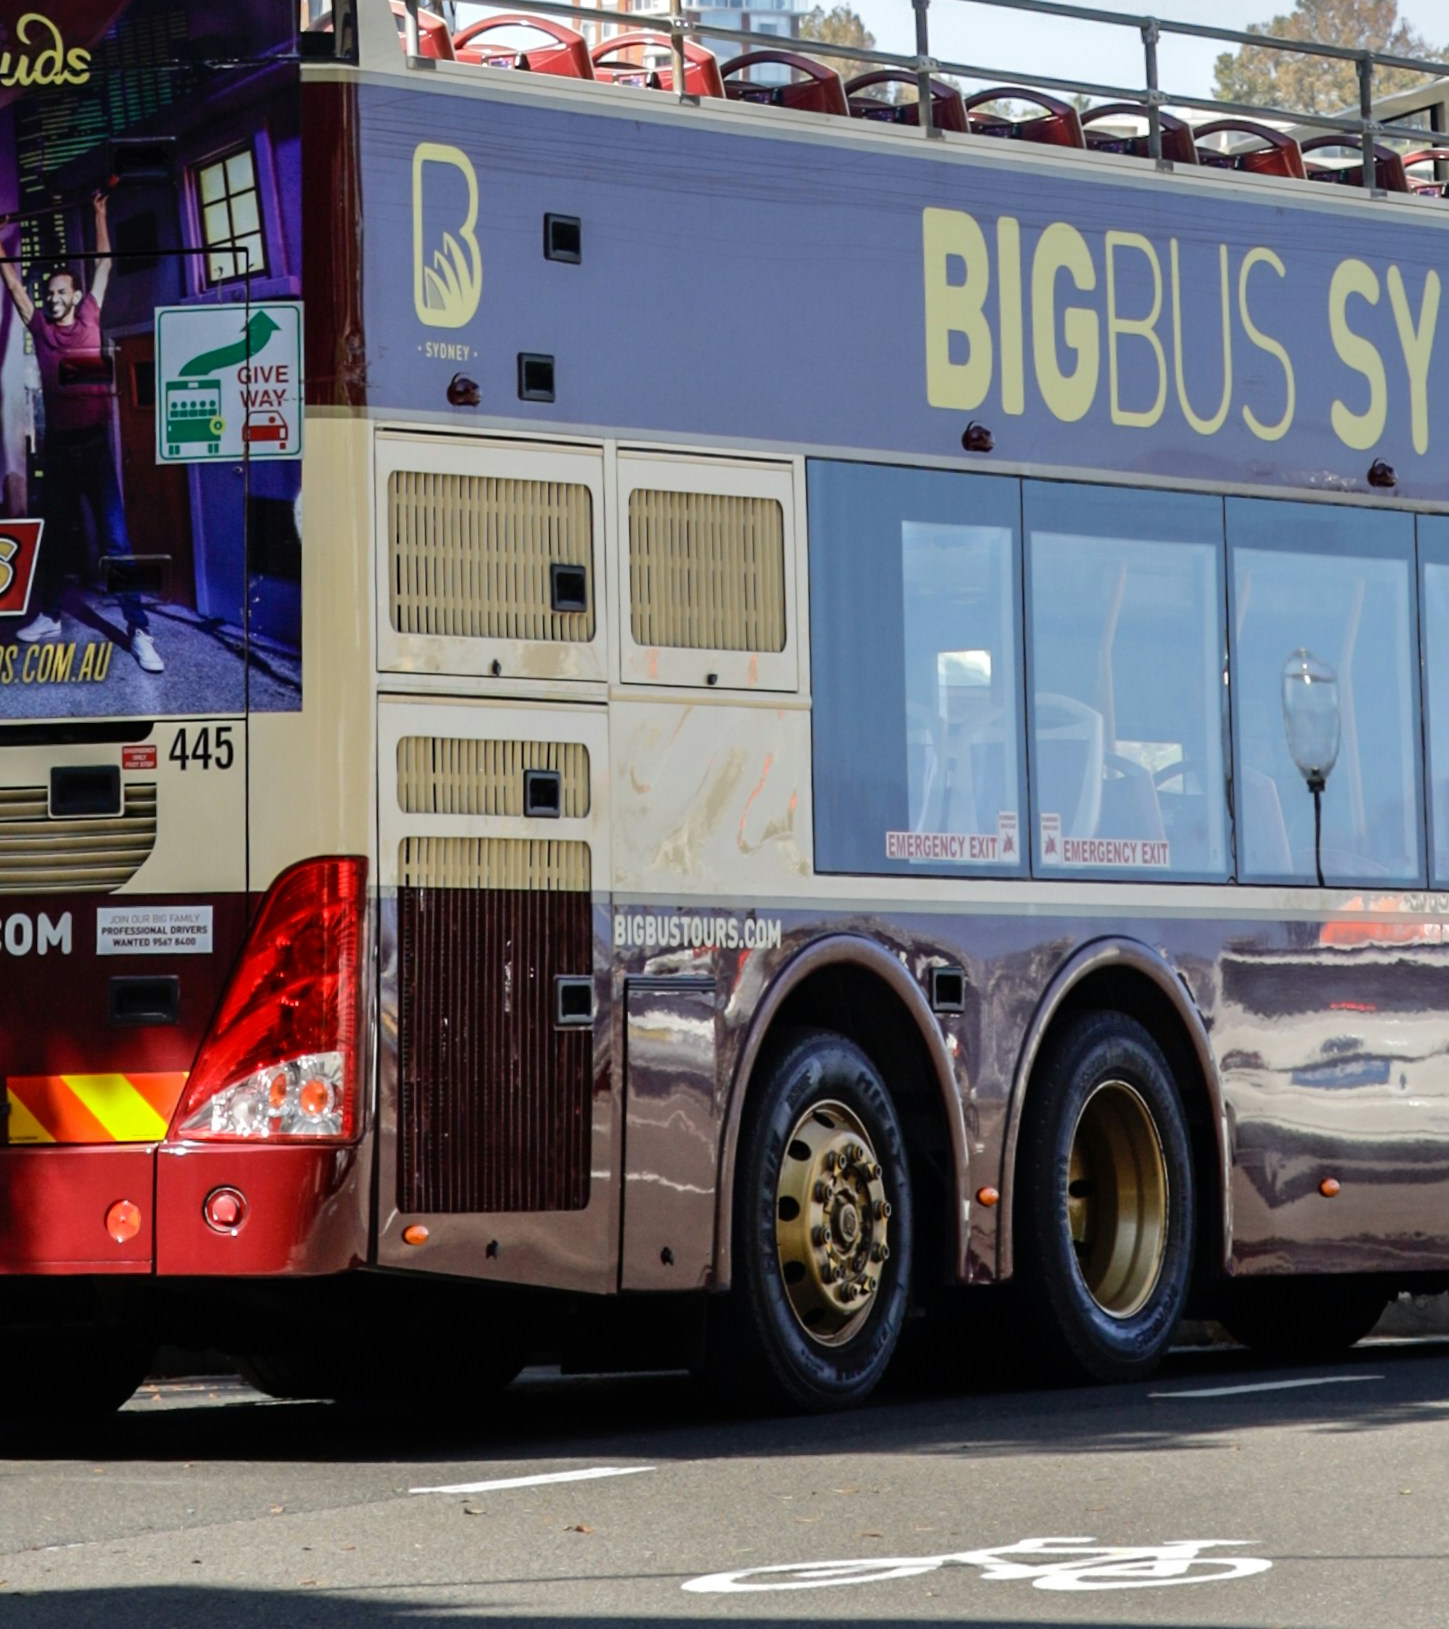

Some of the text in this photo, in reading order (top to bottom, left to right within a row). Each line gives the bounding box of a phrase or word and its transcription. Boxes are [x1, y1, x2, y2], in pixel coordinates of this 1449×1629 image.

[424, 341, 471, 361] SYDNEY
[236, 364, 290, 385] GIVE
[239, 388, 287, 408] WAY
[168, 726, 235, 771] 445
[887, 833, 998, 859] EMERGENCY EXIT
[1063, 840, 1168, 864] EMERGENCY EXIT
[109, 913, 200, 925] JOIN OUR BIG FAMILY
[101, 925, 208, 936] PROFESSIONAL DRIVERS
[614, 913, 782, 949] BIGBUSTOURS.COM
[112, 937, 151, 947] WANTED
[152, 937, 172, 946] 9567
